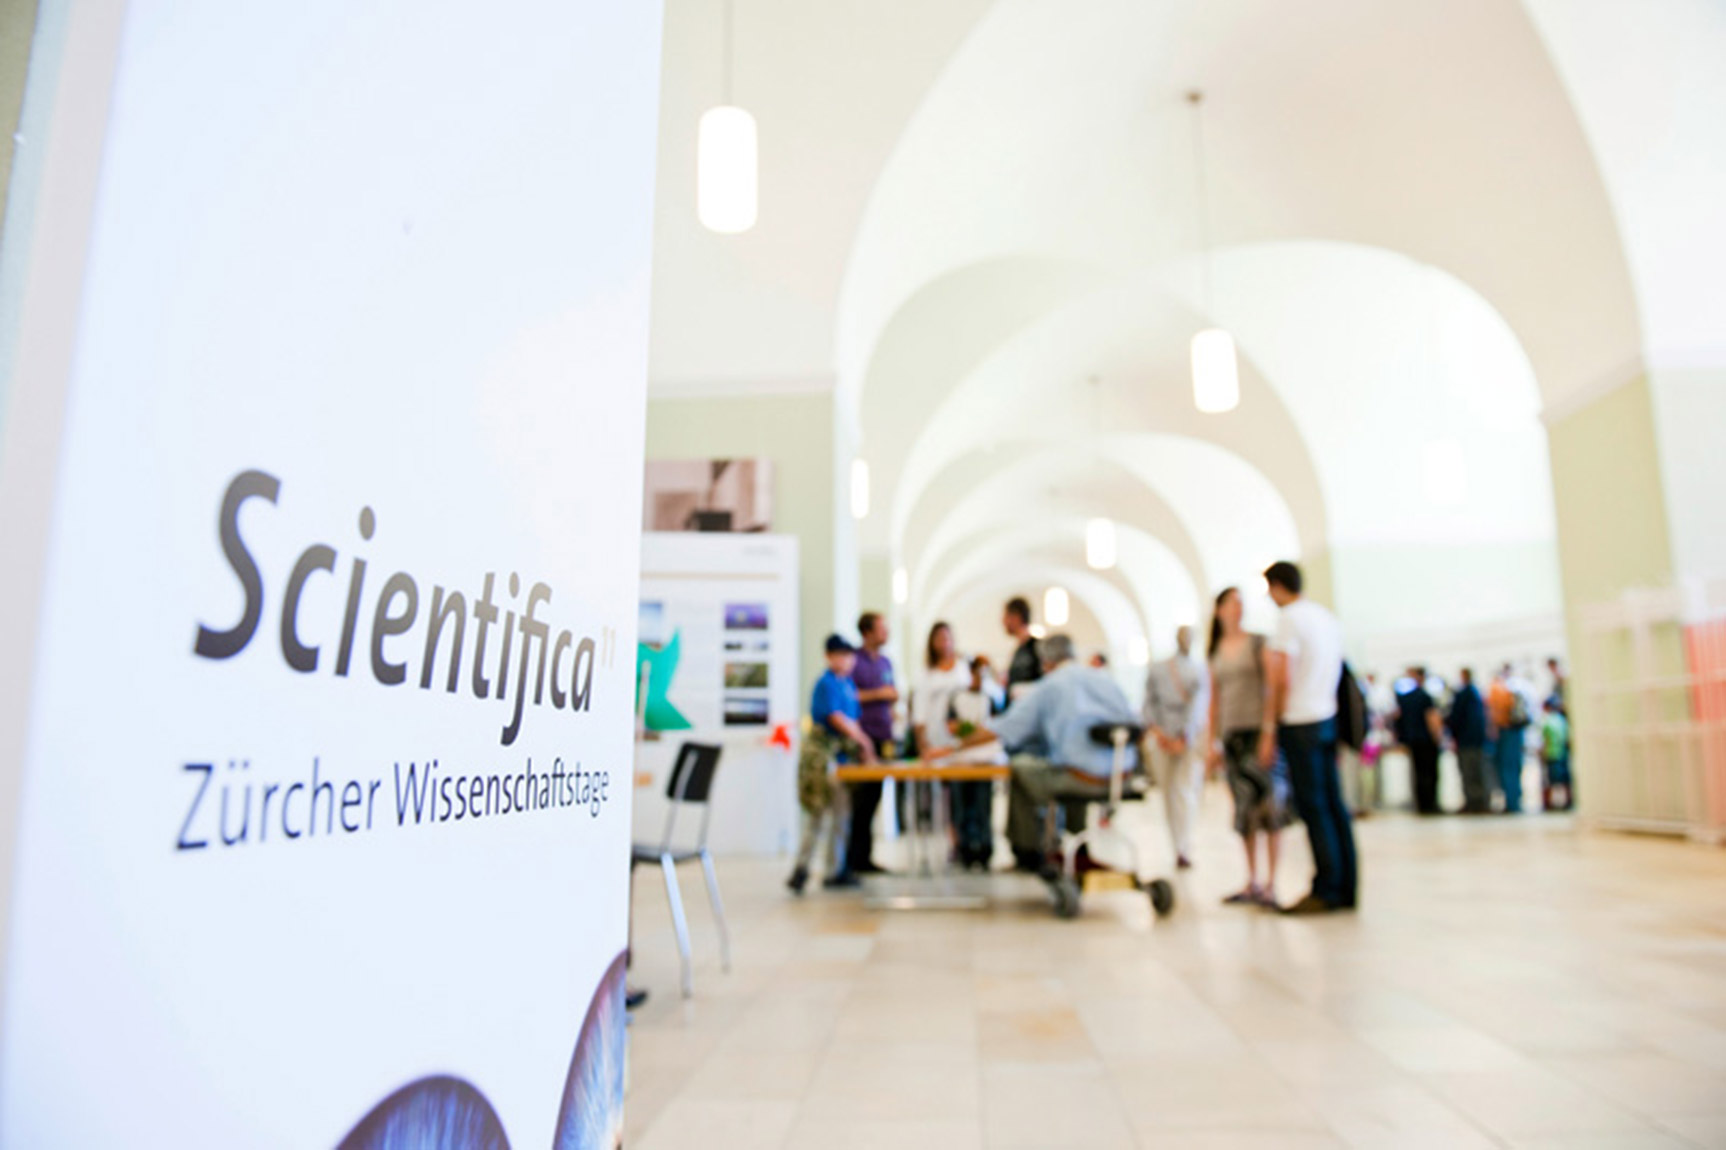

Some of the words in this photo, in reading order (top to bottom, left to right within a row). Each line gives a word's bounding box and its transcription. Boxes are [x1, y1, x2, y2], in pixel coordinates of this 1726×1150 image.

[193, 469, 596, 747] Scientifica
[175, 756, 381, 851] Zürcher
[393, 757, 610, 826] Wissenschaftstage
